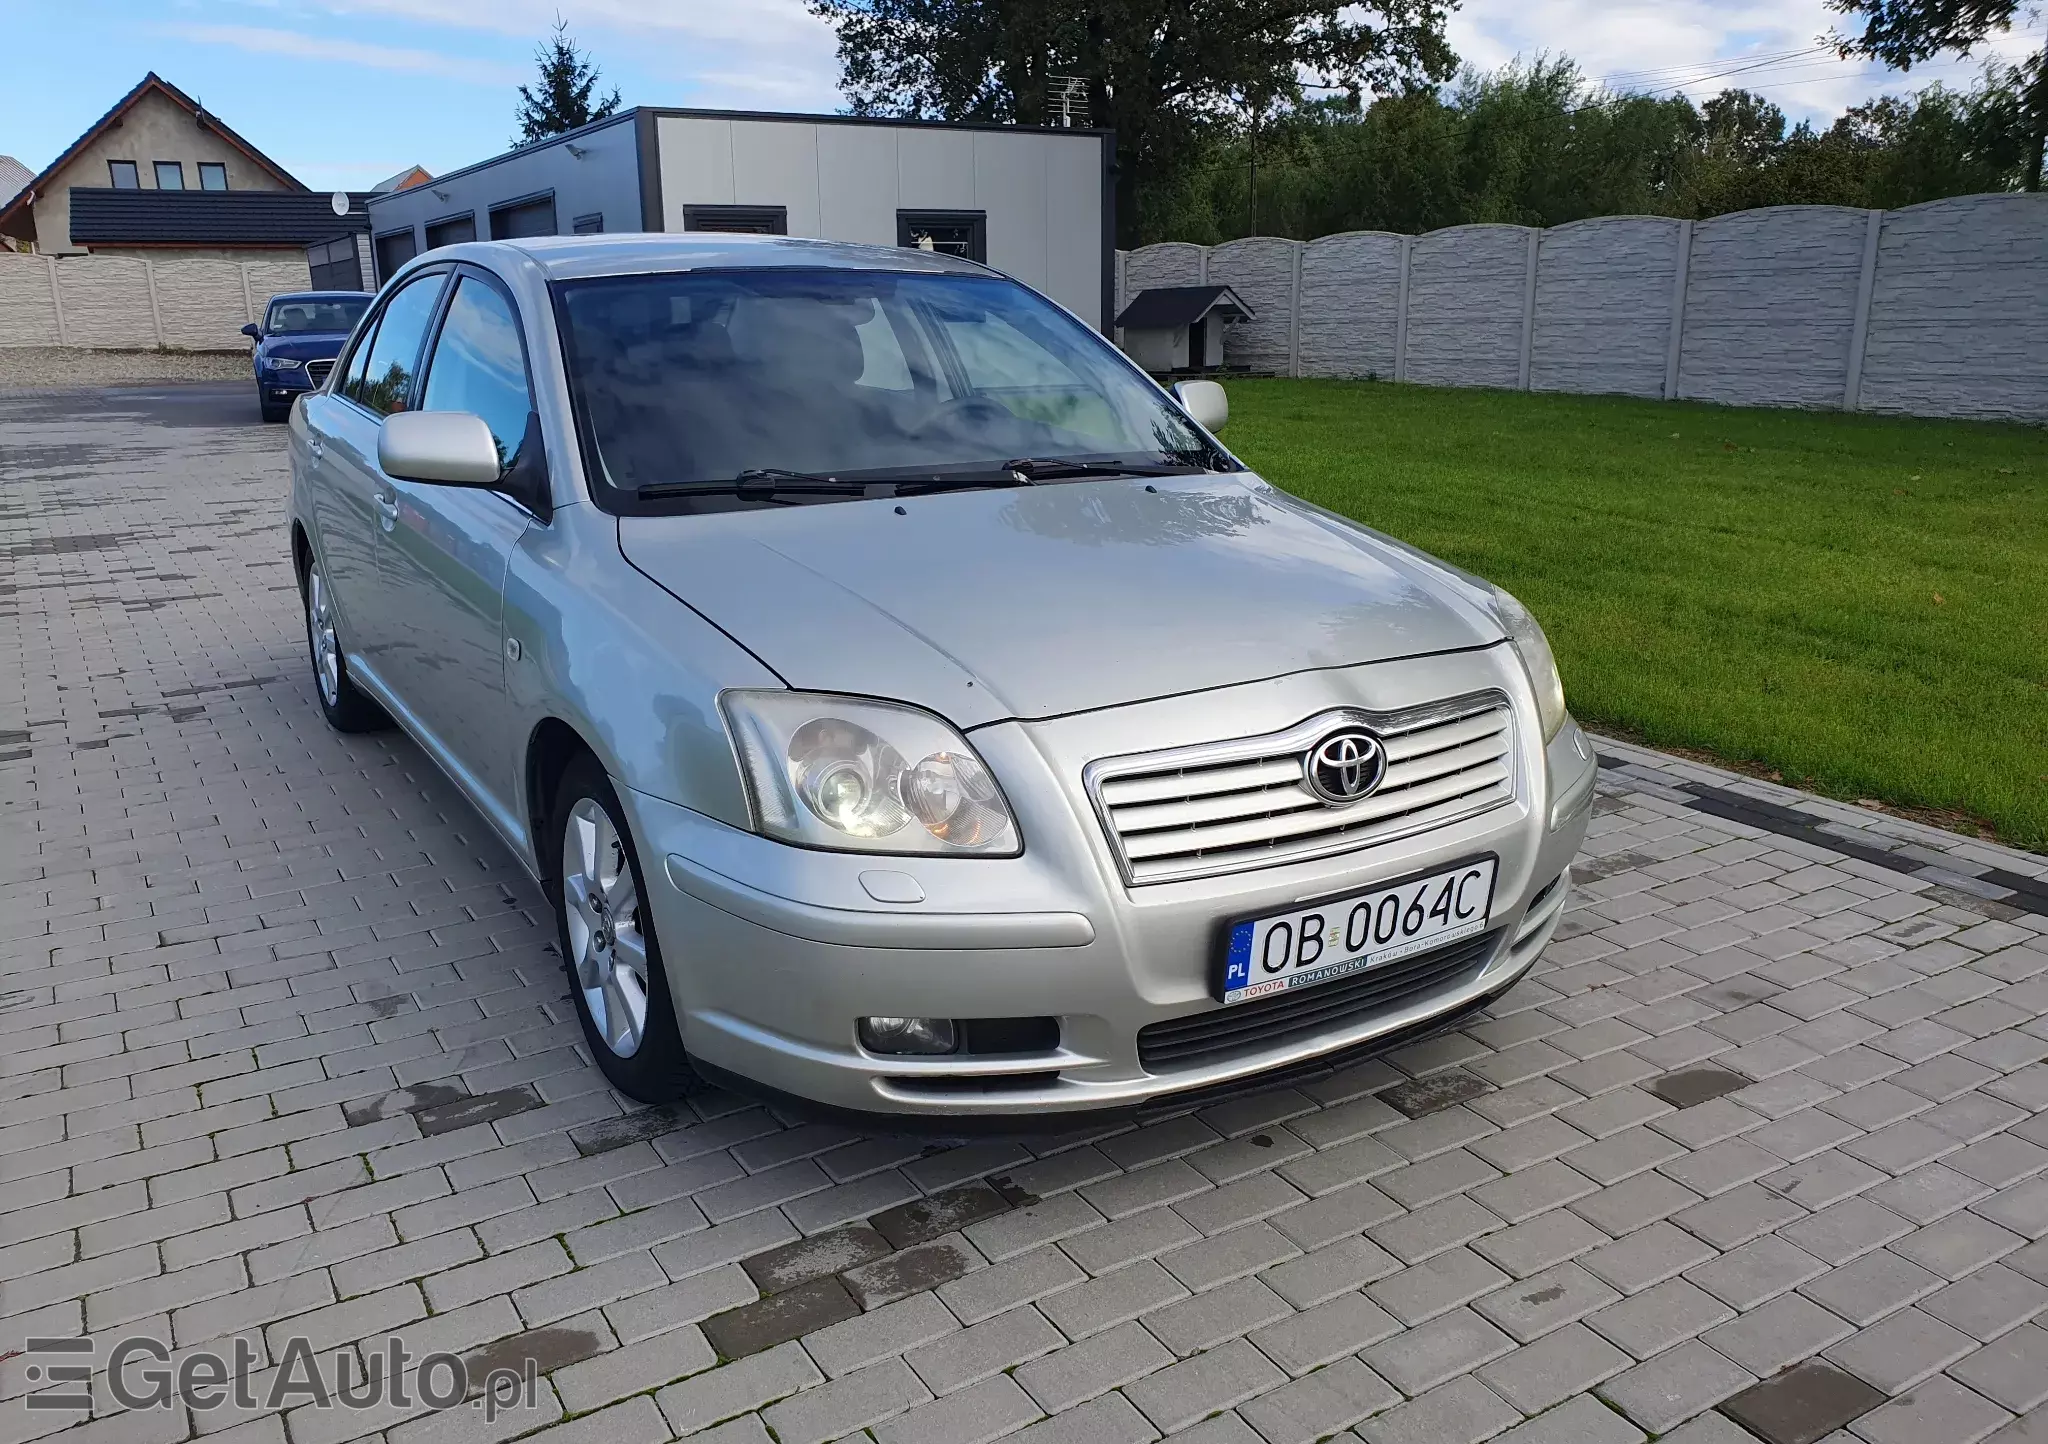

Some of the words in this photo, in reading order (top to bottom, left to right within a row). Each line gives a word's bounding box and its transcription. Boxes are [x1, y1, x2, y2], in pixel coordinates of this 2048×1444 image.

[1262, 914, 1325, 973] OB
[1345, 870, 1481, 952] 0064C
[1228, 963, 1245, 979] PL
[1244, 981, 1284, 997] TOYOTA
[1292, 959, 1366, 985] ROMANOWSKI
[1370, 951, 1398, 963] Kraków
